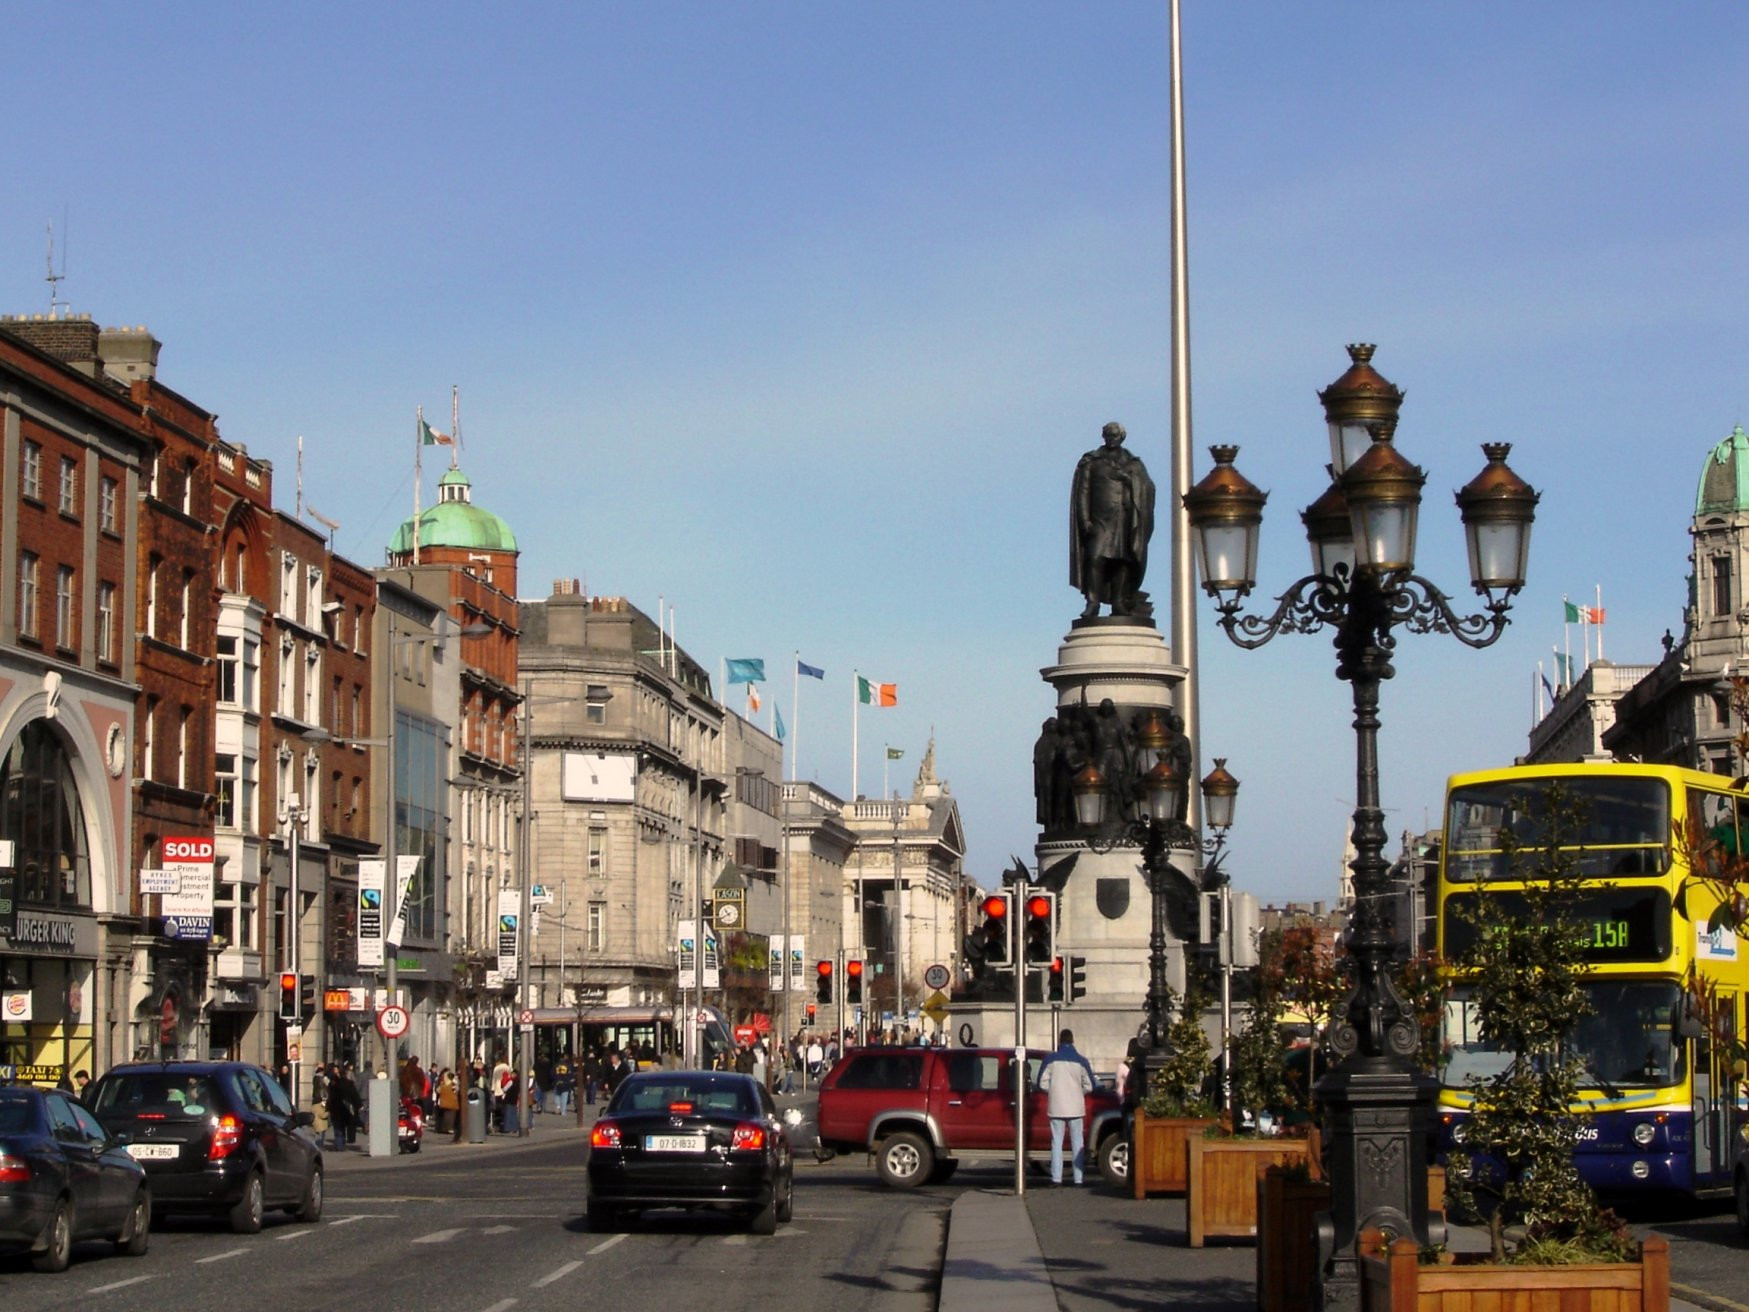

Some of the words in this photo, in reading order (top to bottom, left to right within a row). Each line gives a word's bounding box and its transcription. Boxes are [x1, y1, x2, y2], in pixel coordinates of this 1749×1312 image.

[165, 842, 212, 857] SOLD
[180, 873, 211, 881] mercial
[717, 889, 741, 899] EASON
[179, 917, 210, 927] DAVIN
[11, 918, 49, 942] URGER
[51, 921, 75, 945] KING
[1594, 921, 1628, 947] 15A
[931, 969, 943, 980] 30
[387, 1011, 400, 1024] 30
[26, 1066, 46, 1074] TAXI
